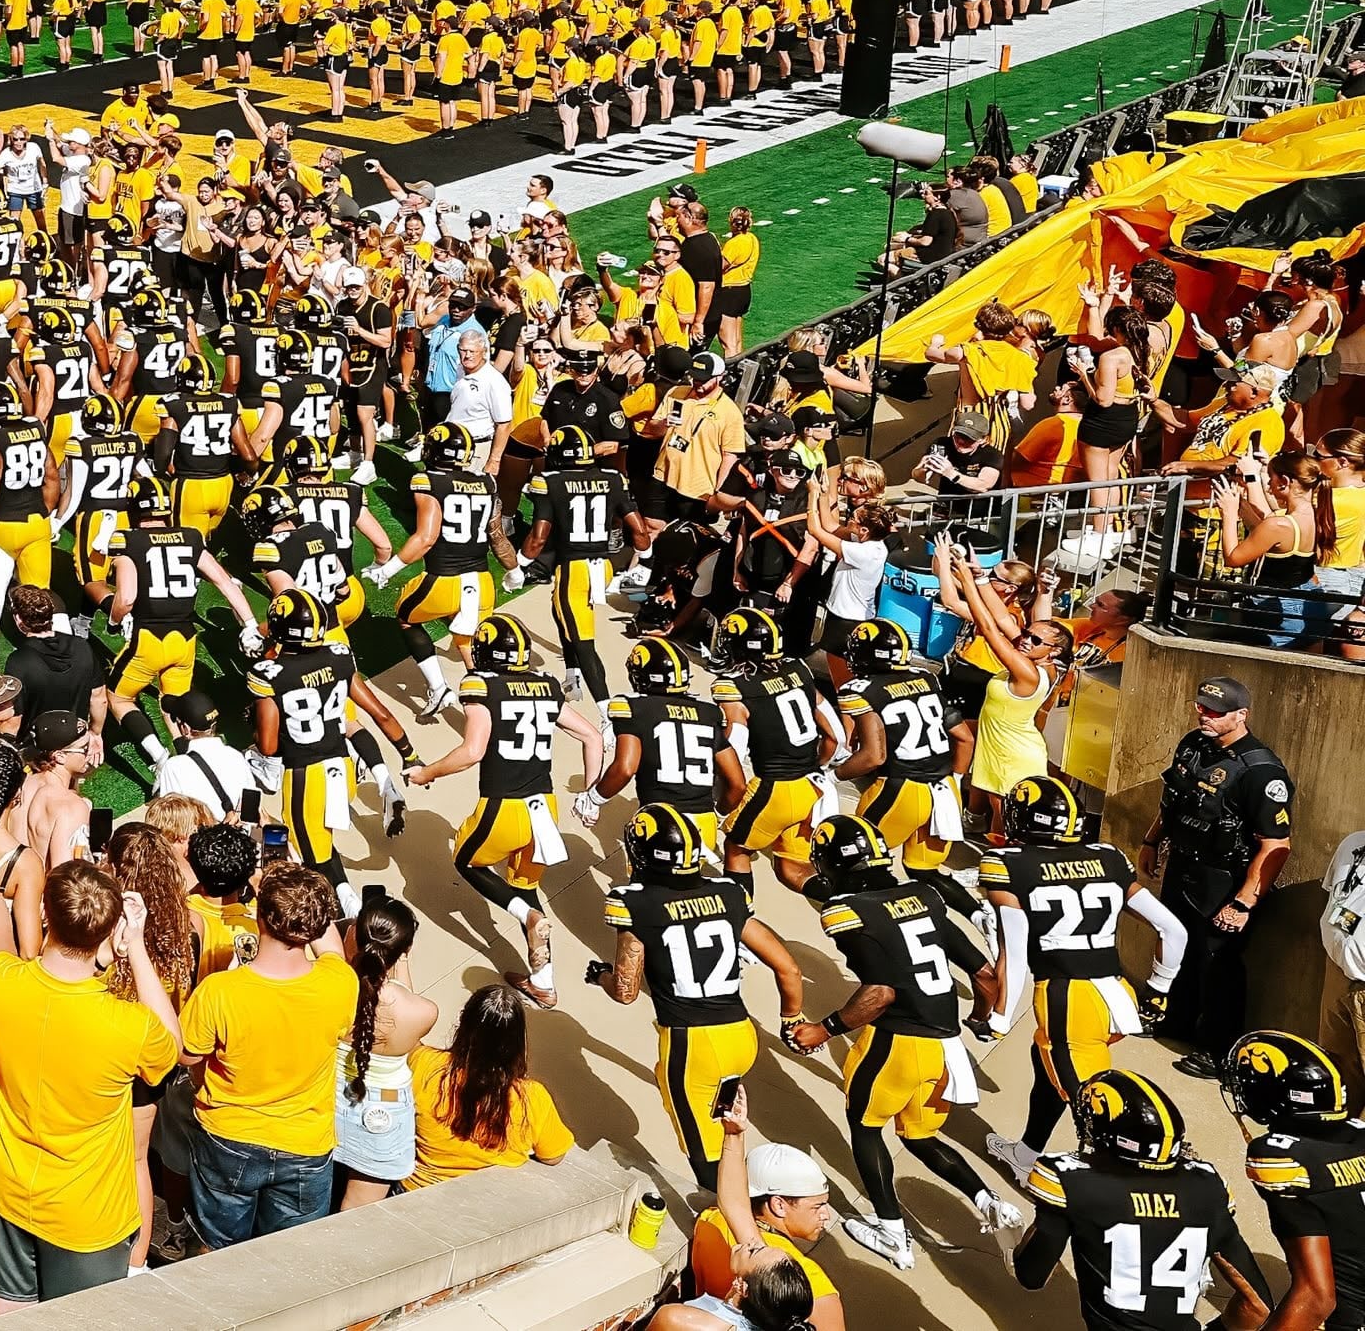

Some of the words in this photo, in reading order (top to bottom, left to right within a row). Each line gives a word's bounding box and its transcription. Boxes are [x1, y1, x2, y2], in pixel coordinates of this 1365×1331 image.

[179, 413, 233, 456] 43
[4, 440, 47, 490] 88
[89, 455, 136, 500] 21
[564, 480, 611, 495] WALLACE
[441, 494, 493, 544] 97
[569, 495, 609, 543] 11
[145, 545, 199, 599] 15
[300, 667, 335, 689] PAYNE
[505, 680, 553, 698] PHILPOTT
[281, 678, 348, 745] 84
[497, 699, 556, 762] 35
[665, 705, 699, 722] DEAN
[774, 687, 819, 747] 0
[883, 692, 951, 762] 28
[653, 721, 718, 787] 15
[1040, 858, 1106, 882] JACKSON
[663, 893, 727, 922] WEIVODA
[881, 895, 929, 920] McNEIL
[1027, 881, 1125, 953] 22
[661, 919, 742, 1000] 12
[896, 919, 955, 997] 5
[1129, 1191, 1181, 1220] DIAZ
[1101, 1221, 1209, 1315] 14
